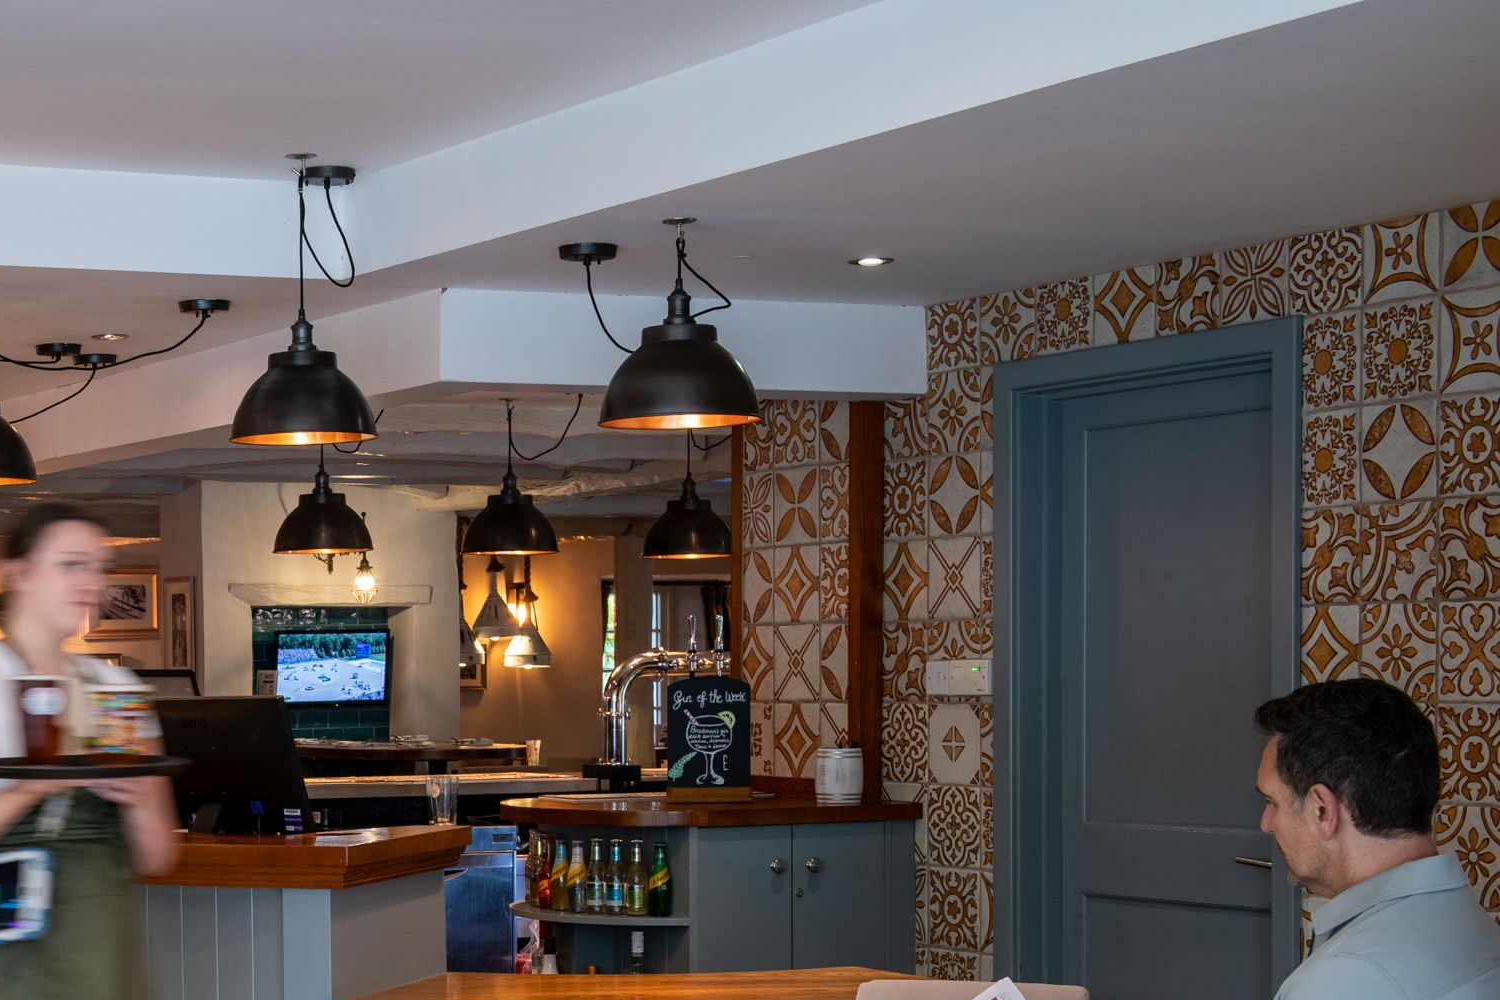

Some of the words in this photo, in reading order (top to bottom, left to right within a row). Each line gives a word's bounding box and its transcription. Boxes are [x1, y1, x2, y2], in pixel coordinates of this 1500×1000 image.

[672, 690, 692, 710] Gin
[697, 691, 707, 708] of
[709, 689, 723, 703] the
[725, 691, 746, 702] Week
